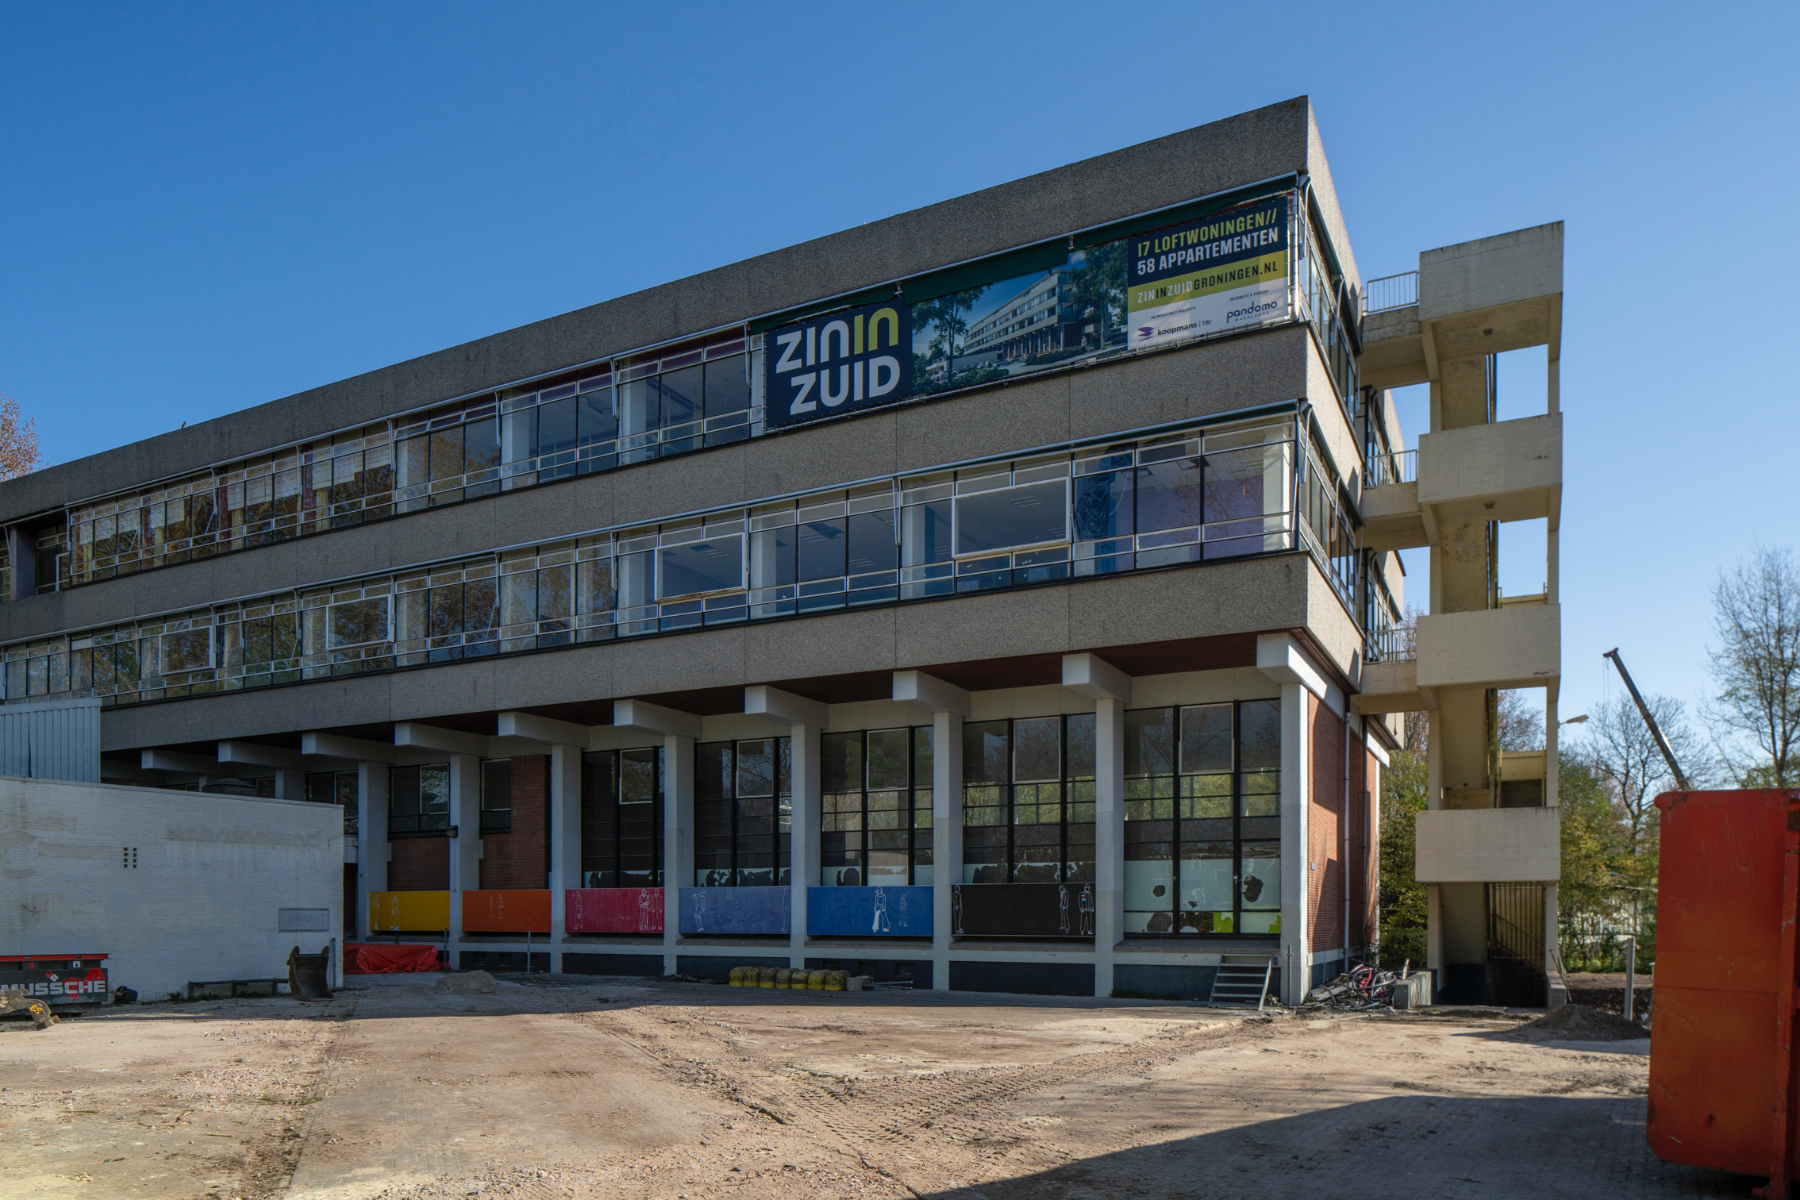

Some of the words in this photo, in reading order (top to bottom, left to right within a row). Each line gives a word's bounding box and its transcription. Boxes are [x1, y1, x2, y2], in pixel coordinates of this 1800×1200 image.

[1137, 241, 1151, 258] 17
[1154, 208, 1278, 253] LOFTWONINGEN//
[1137, 258, 1156, 276] 58
[1158, 227, 1279, 271] APPARTEMENTEN
[1157, 322, 1198, 336] koopmans
[1226, 301, 1278, 324] pandomo
[790, 355, 901, 416] ZUID
